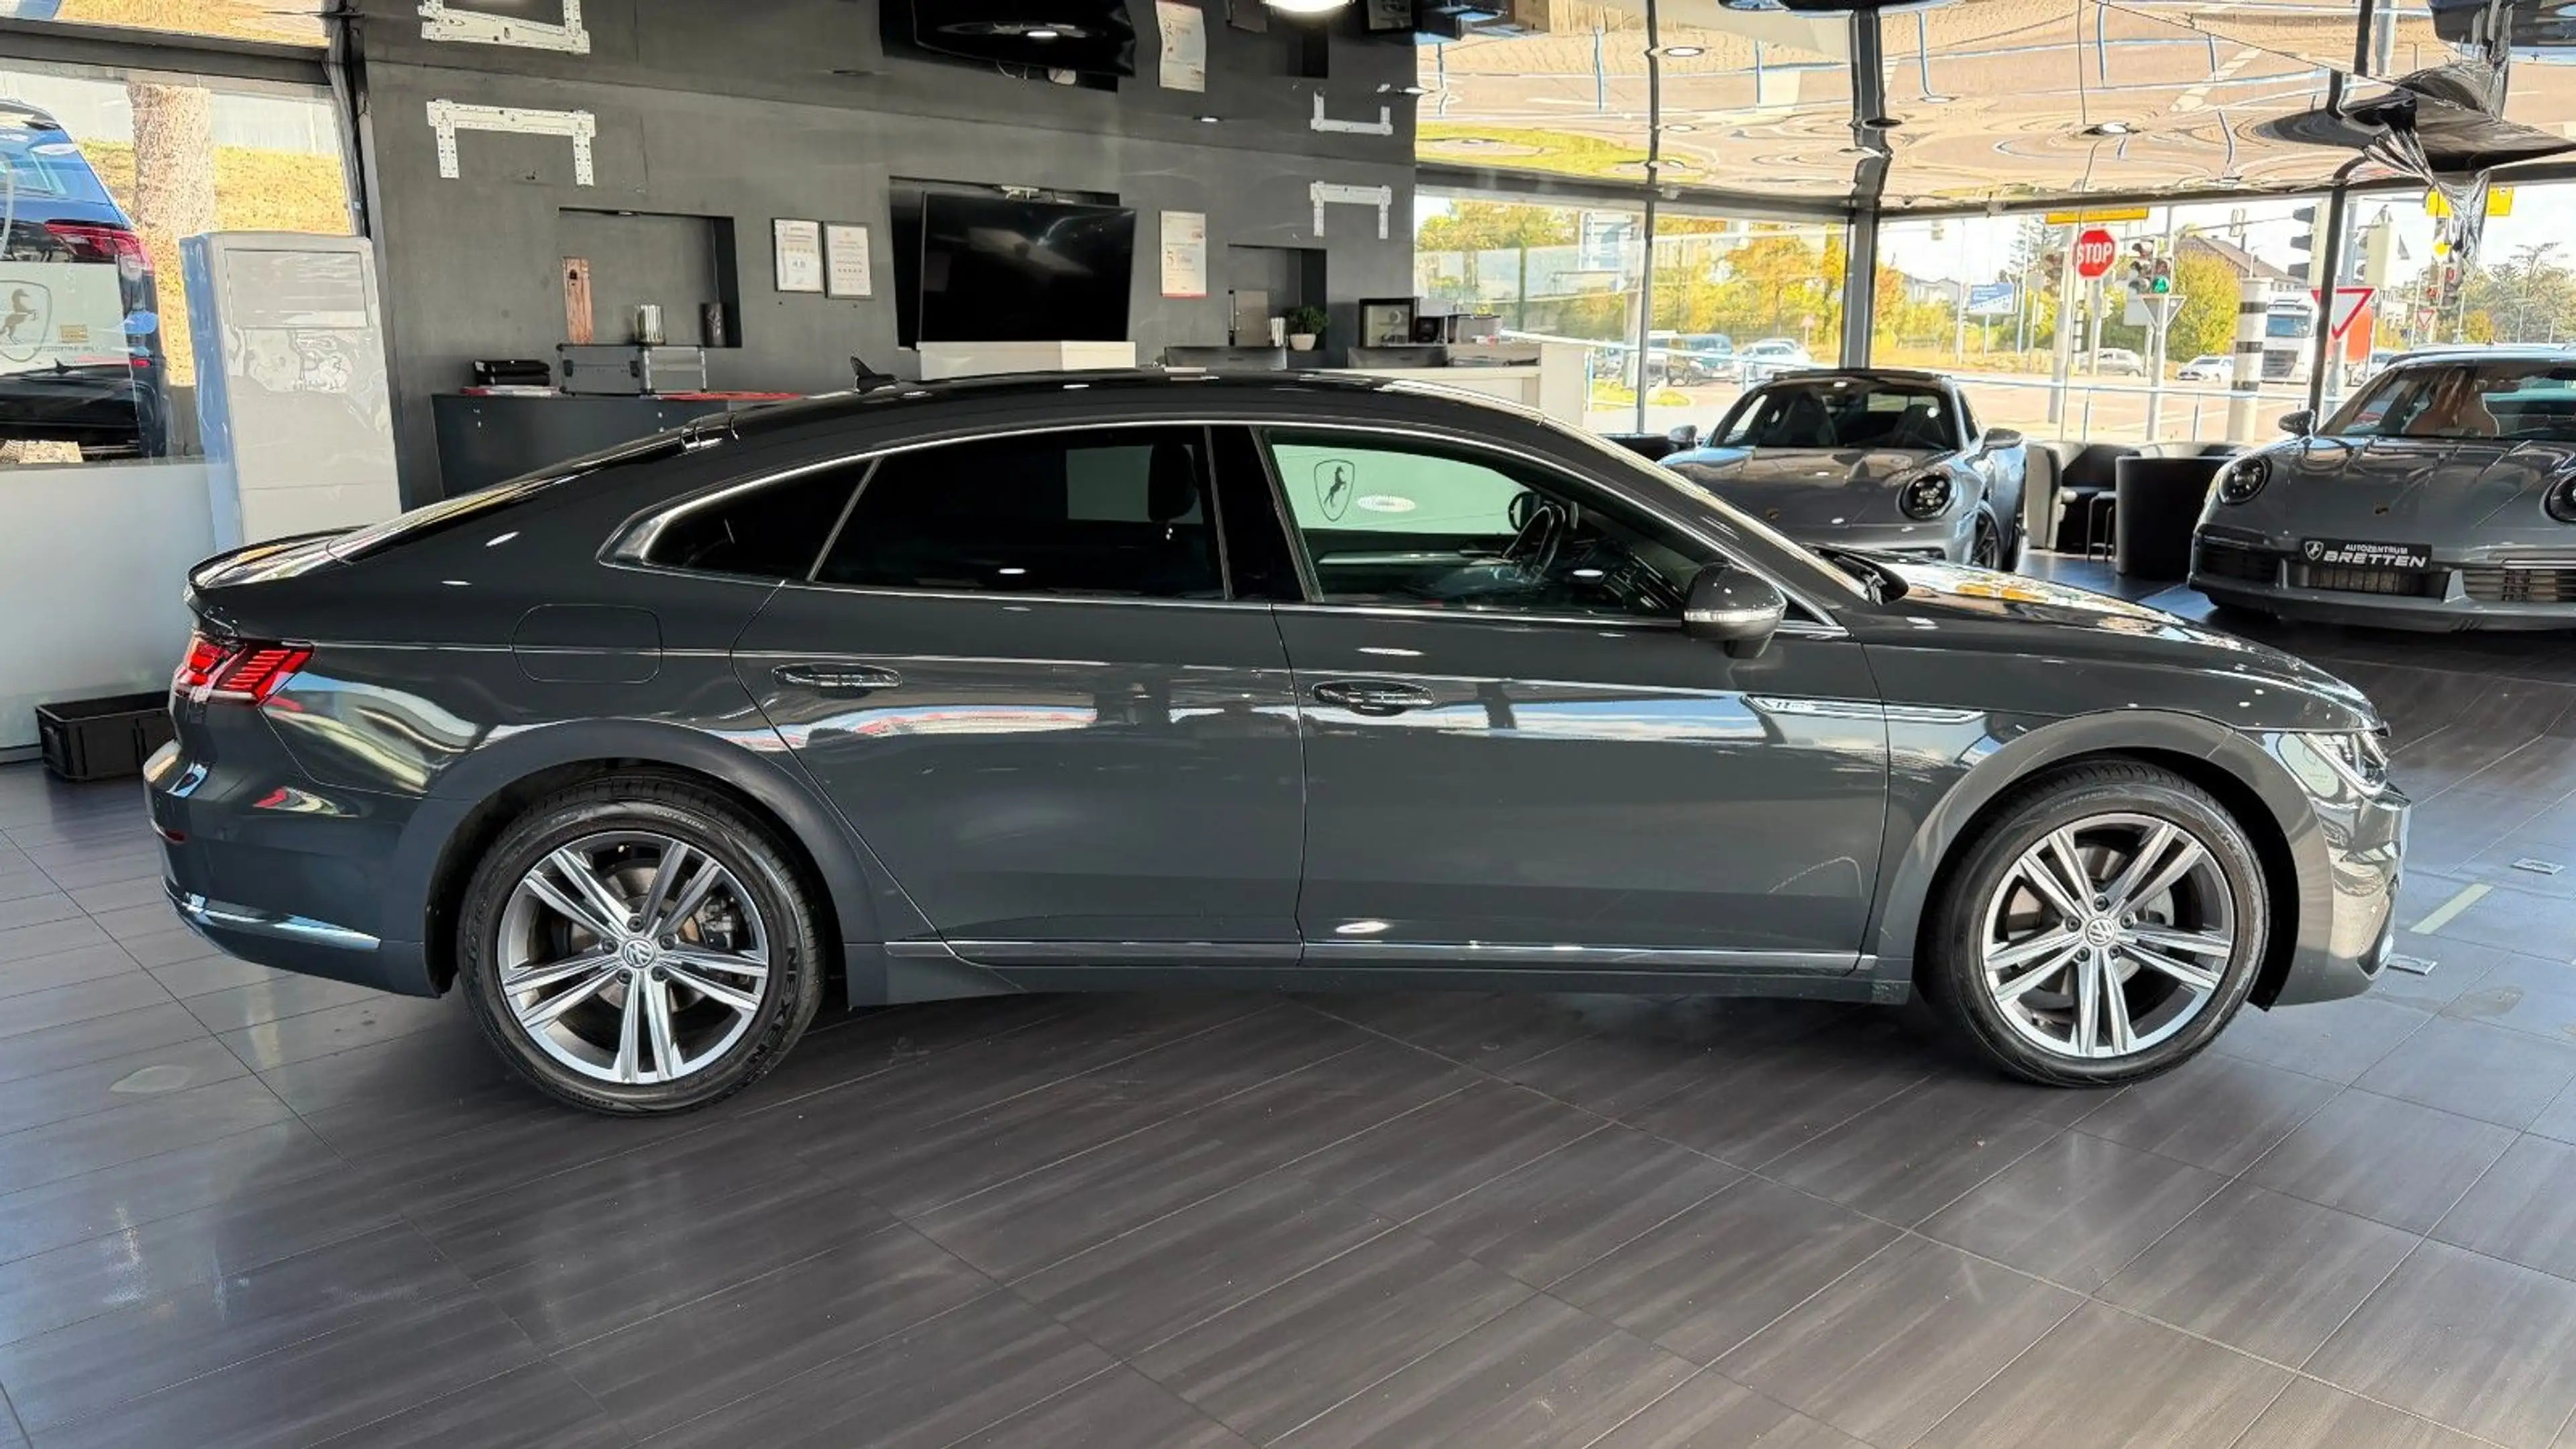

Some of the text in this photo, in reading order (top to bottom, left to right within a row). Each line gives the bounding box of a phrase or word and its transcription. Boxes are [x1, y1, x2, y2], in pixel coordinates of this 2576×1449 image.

[2077, 242, 2112, 264] STOP
[2345, 543, 2408, 554] AUTOZENTRUM
[2323, 550, 2427, 568] BRETTEN
